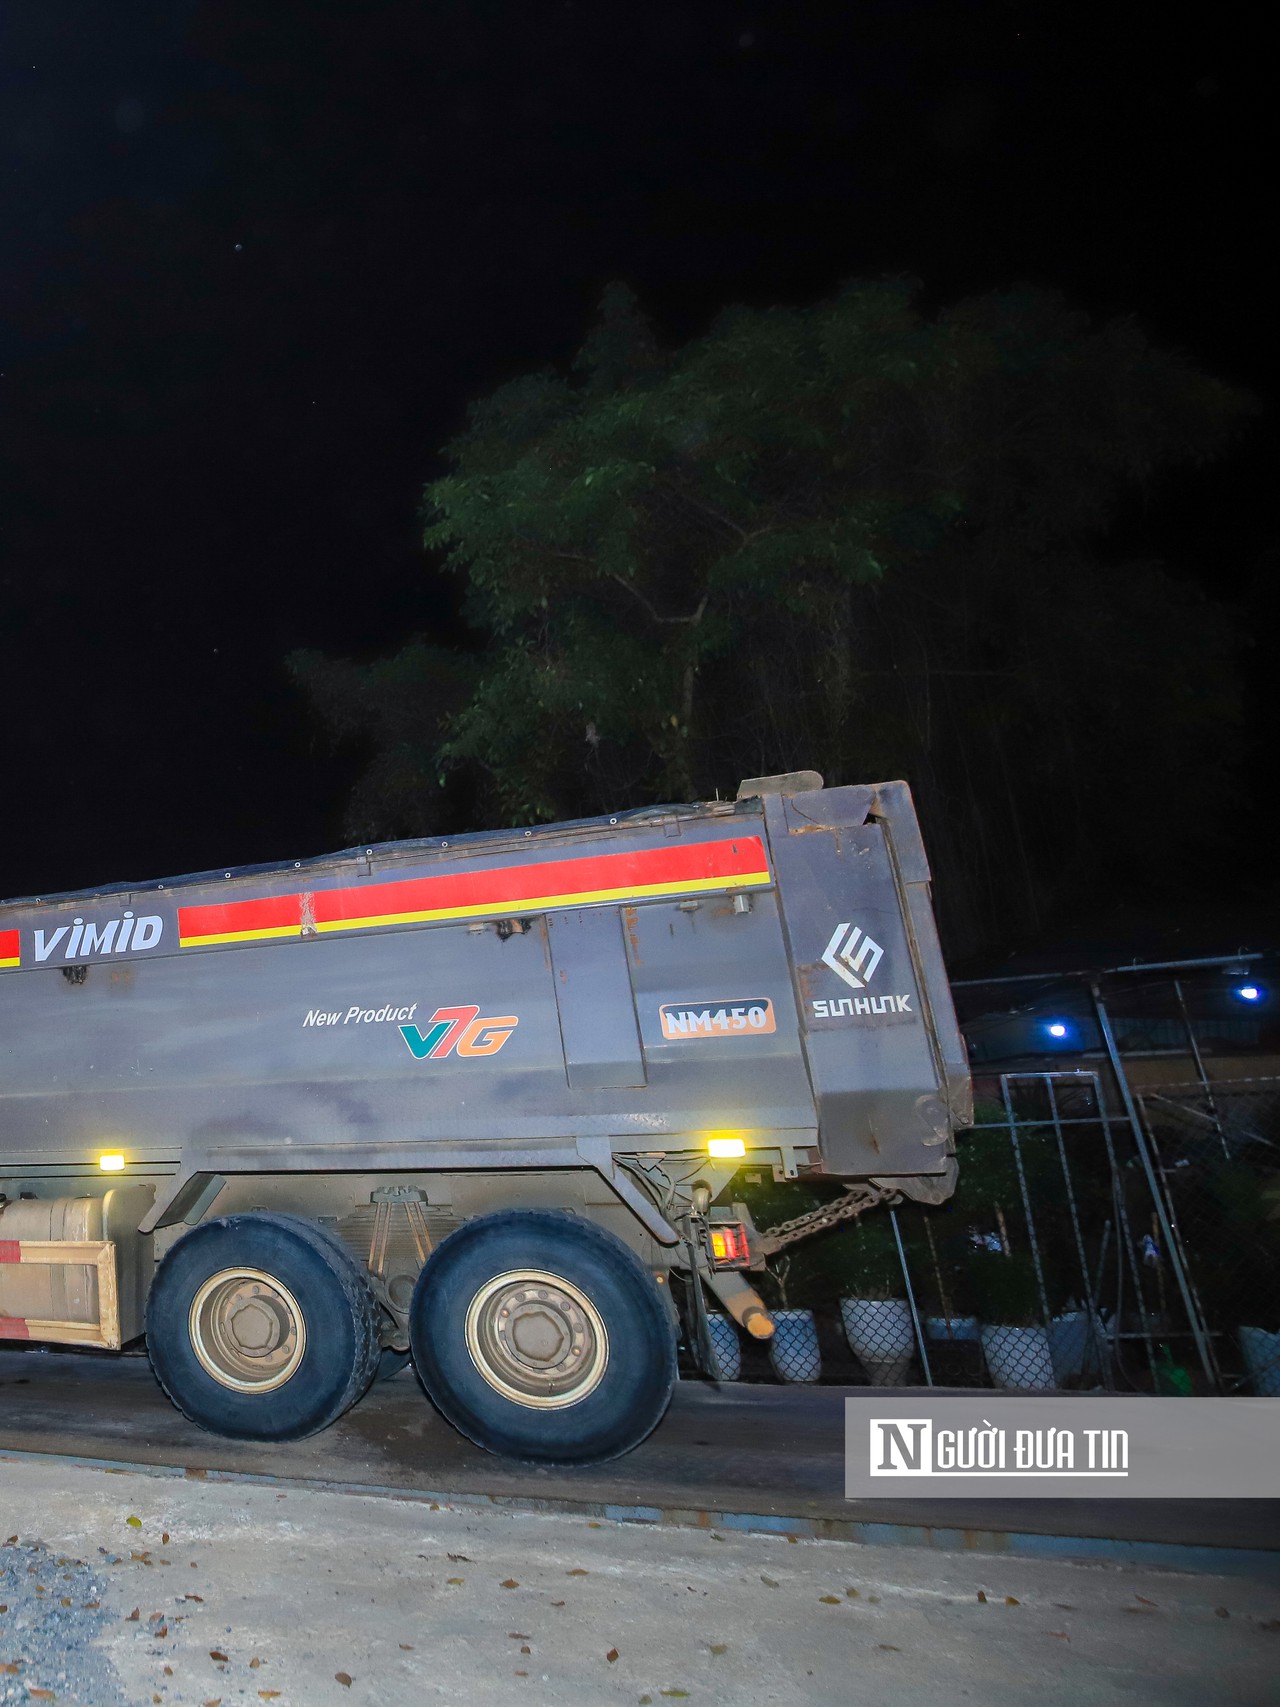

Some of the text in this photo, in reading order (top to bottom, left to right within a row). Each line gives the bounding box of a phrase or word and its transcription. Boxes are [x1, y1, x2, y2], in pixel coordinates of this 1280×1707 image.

[303, 1002, 418, 1028] New Product
[665, 1006, 768, 1034] NM450
[398, 1004, 519, 1060] V7G
